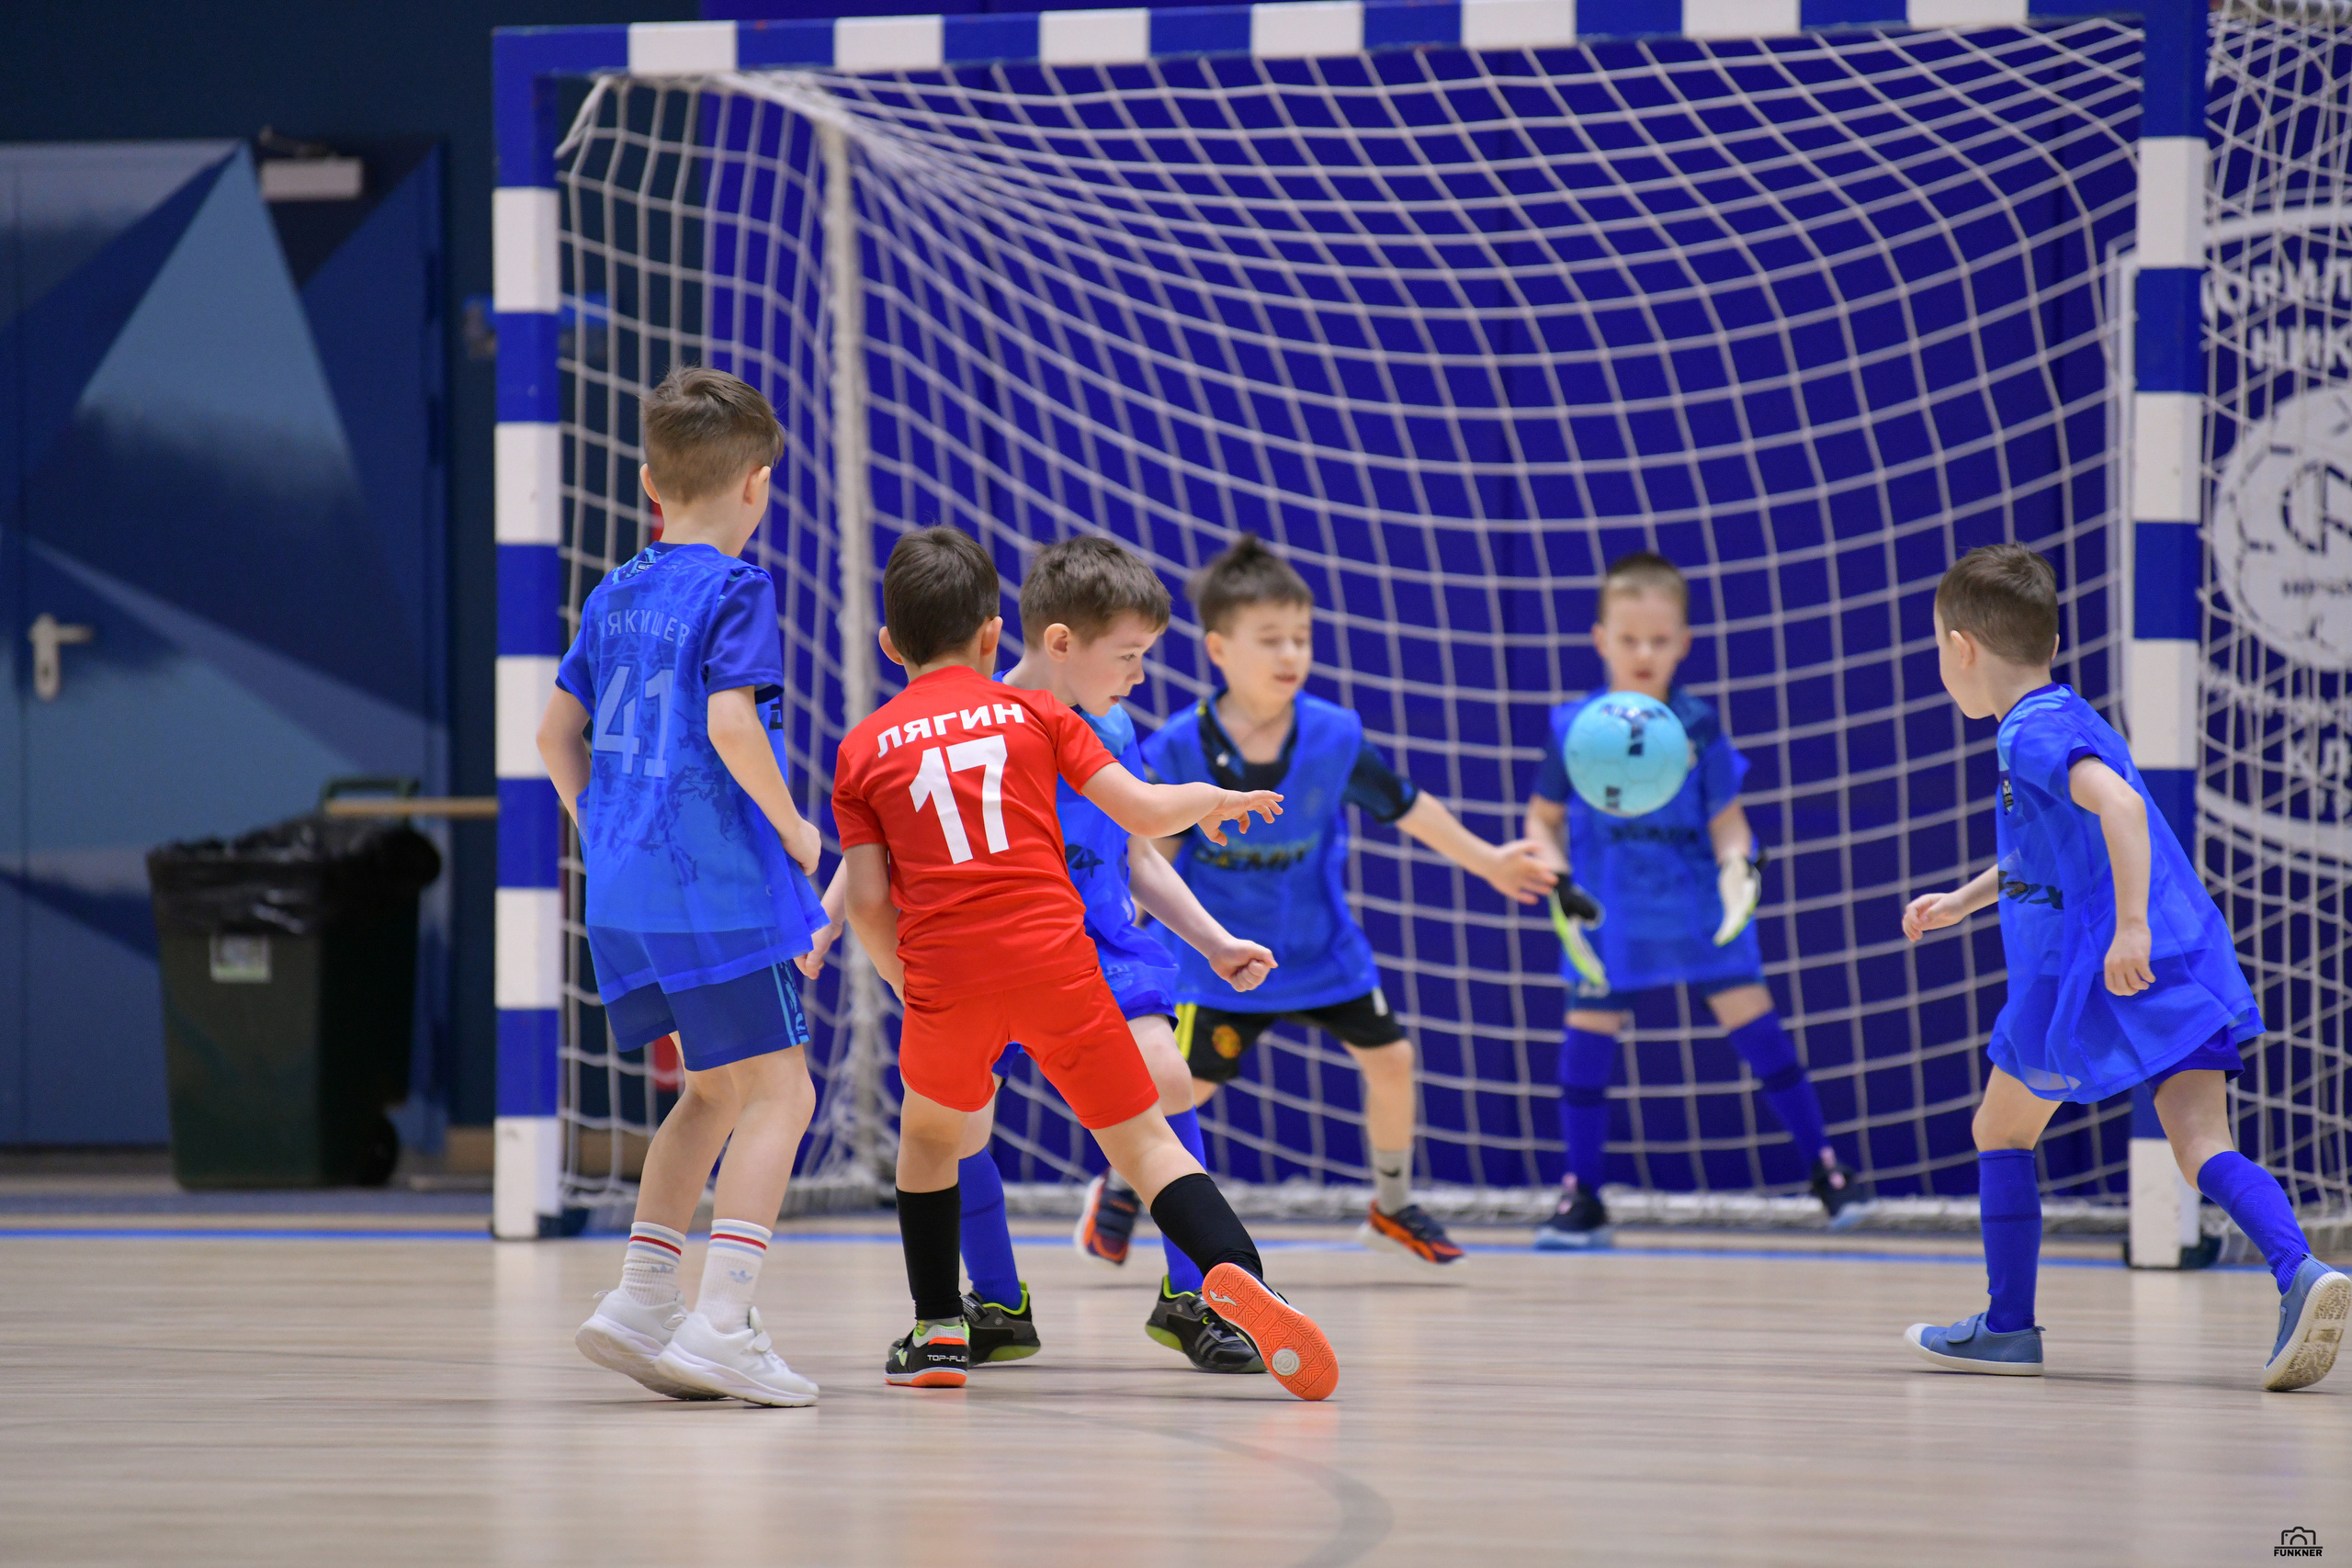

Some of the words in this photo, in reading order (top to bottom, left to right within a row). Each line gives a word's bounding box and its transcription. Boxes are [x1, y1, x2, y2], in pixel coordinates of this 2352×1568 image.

[594, 665, 675, 778] 41
[876, 703, 1025, 759] ЛЯГИН
[908, 734, 1010, 865] 17
